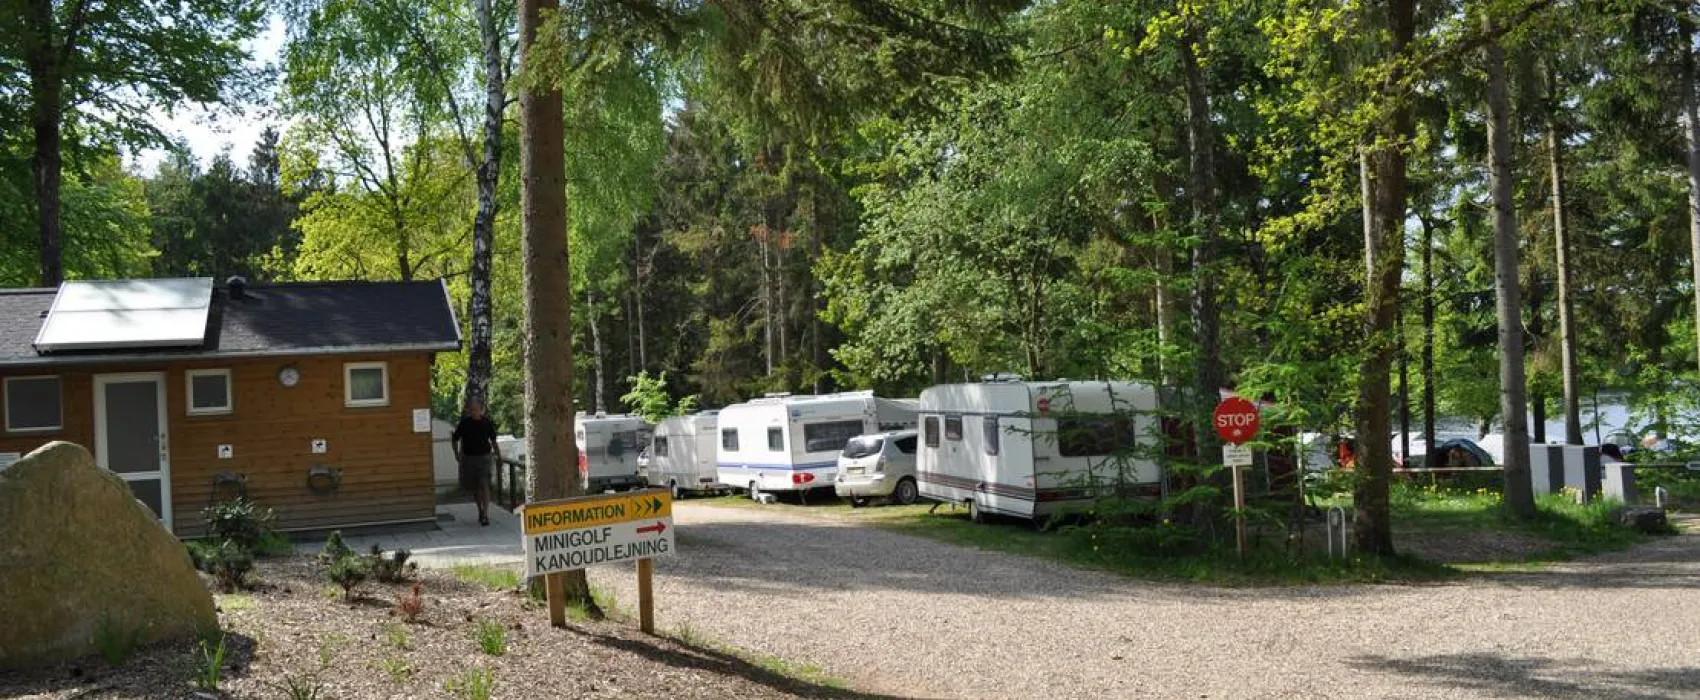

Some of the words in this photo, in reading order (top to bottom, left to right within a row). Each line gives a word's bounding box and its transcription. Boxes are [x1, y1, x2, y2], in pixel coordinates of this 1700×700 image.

[1217, 413, 1255, 428] STOP
[528, 504, 625, 528] INFORMATION
[535, 527, 612, 552] MINIGOLF
[536, 538, 668, 572] KANOUDLEJNING
